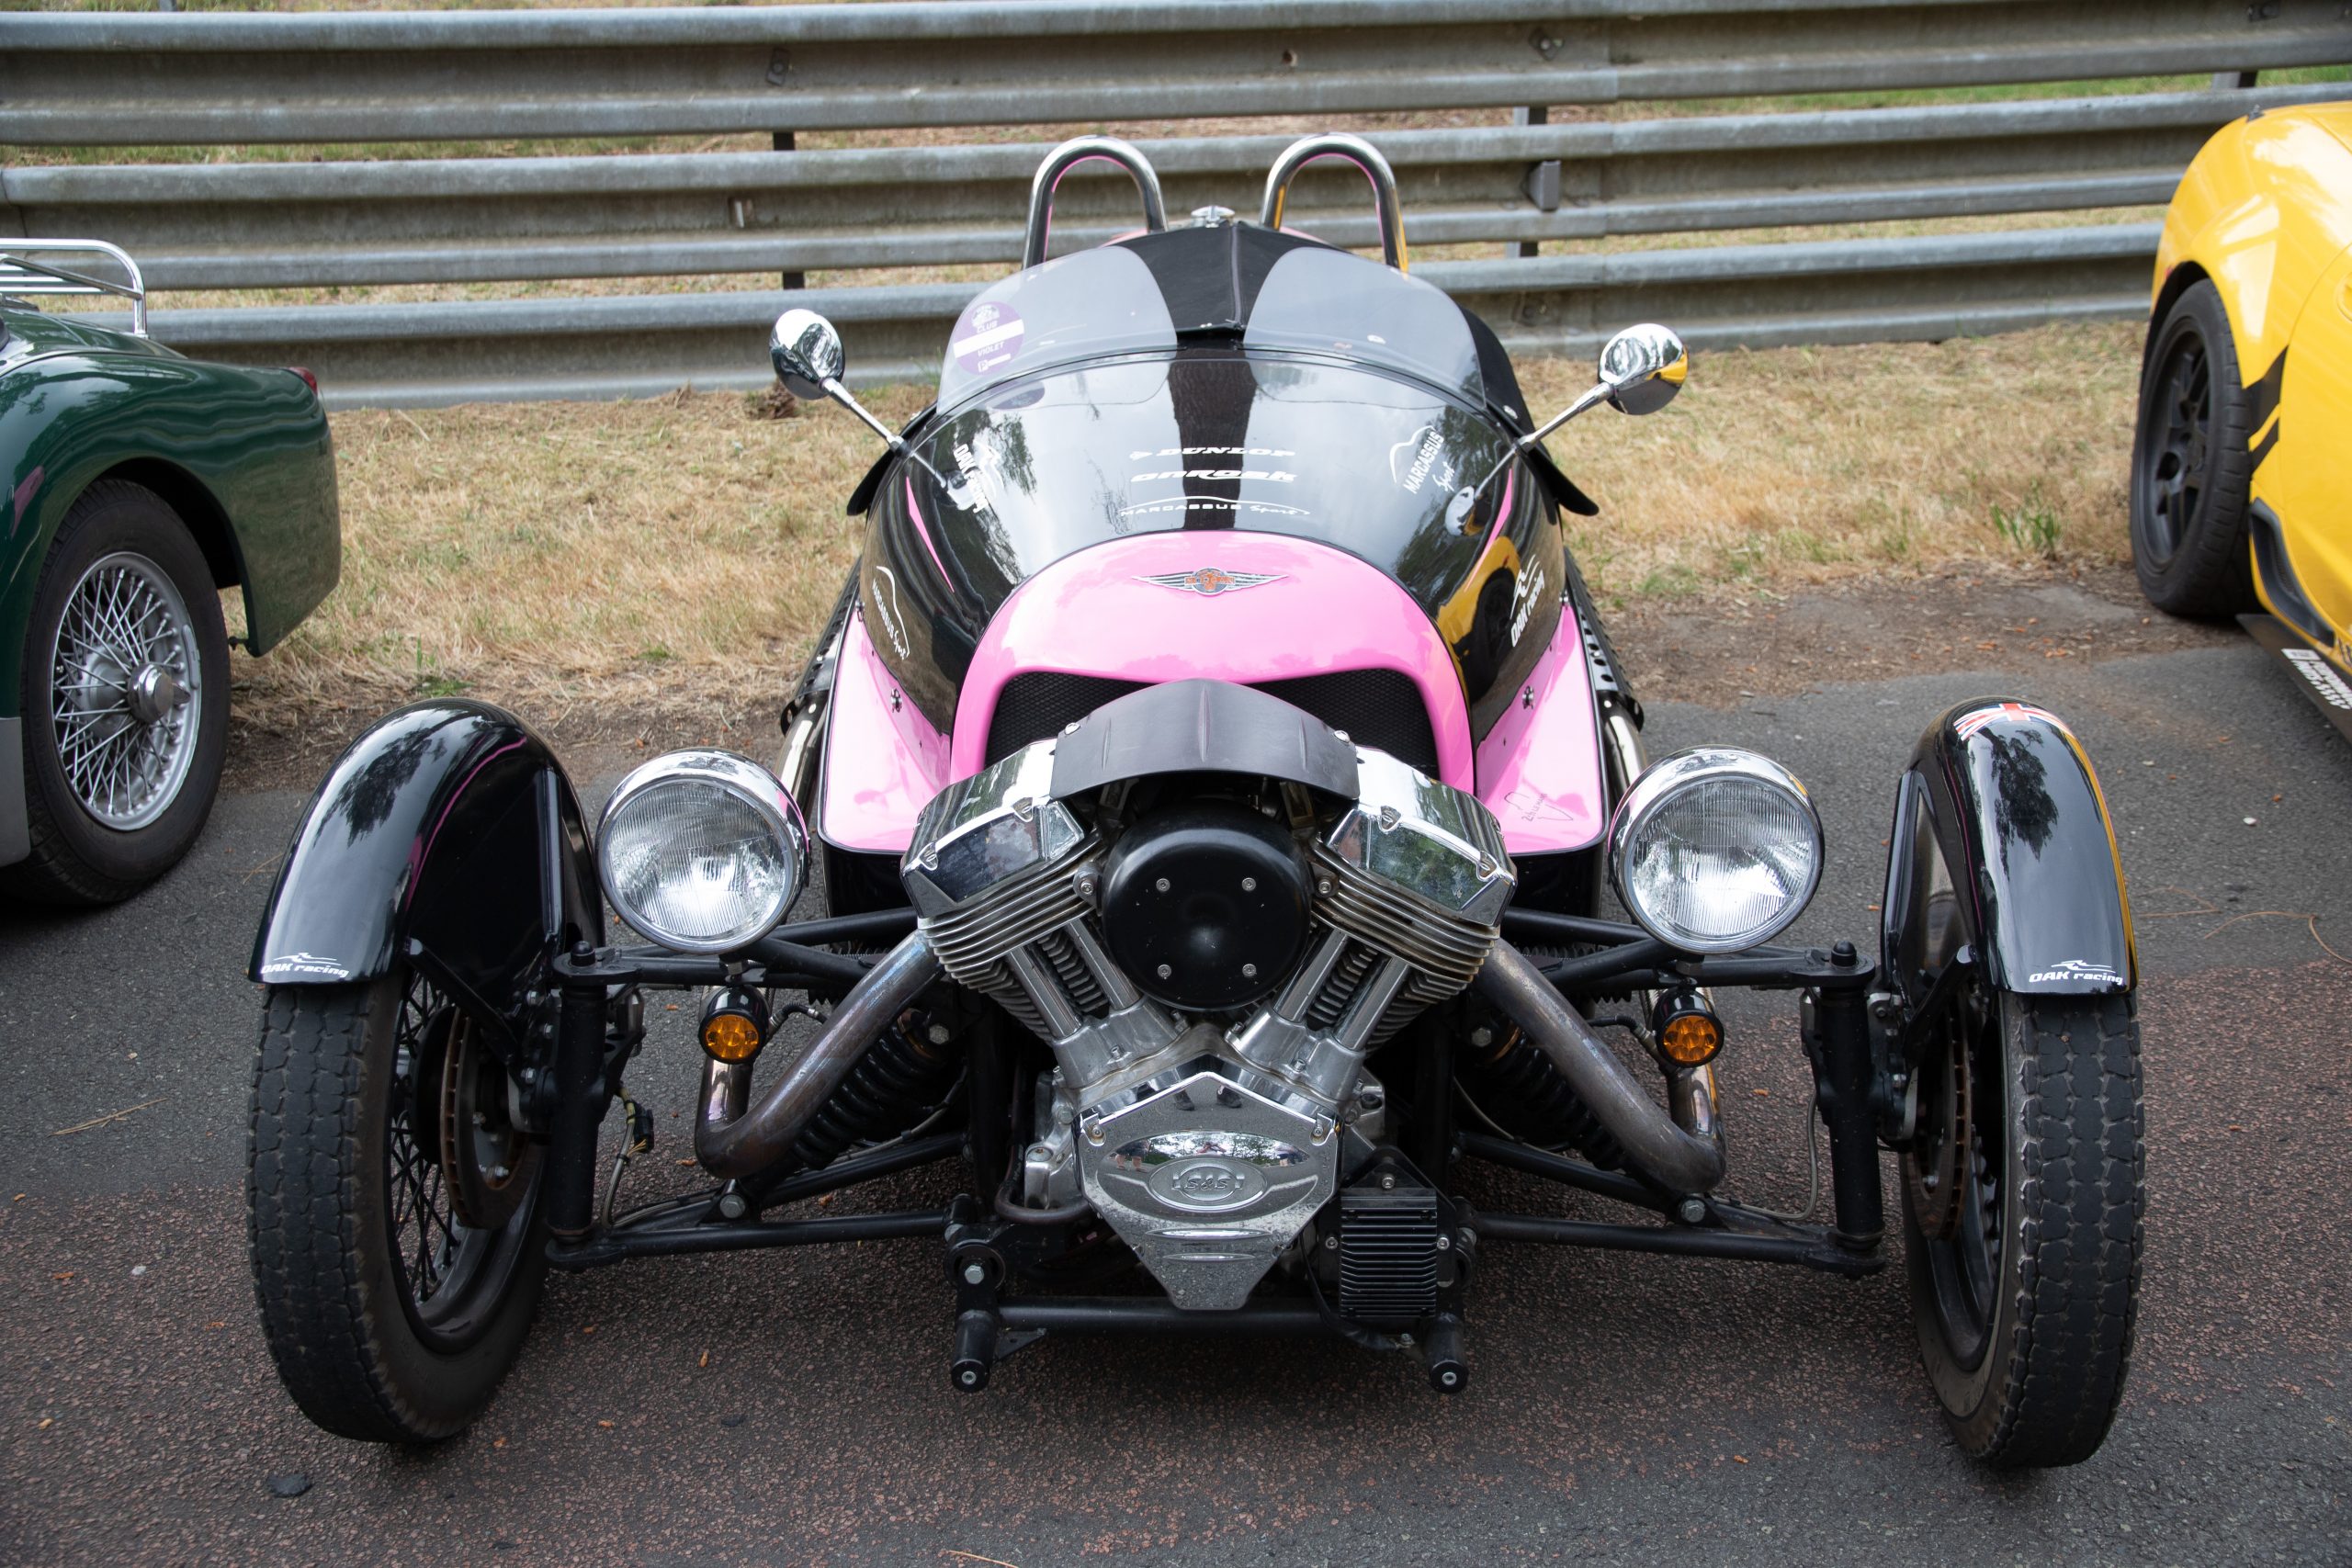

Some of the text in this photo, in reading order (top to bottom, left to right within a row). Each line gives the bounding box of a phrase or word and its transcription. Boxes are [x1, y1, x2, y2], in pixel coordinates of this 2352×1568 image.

[978, 341, 1005, 357] VIOLET
[953, 443, 977, 474] OAK
[1156, 446, 1296, 457] DUNLOP
[1402, 430, 1445, 494] MARCASSUS
[260, 963, 350, 978] OAK racing
[2029, 971, 2123, 986] OAK racing
[1183, 1175, 1232, 1191] S&S
